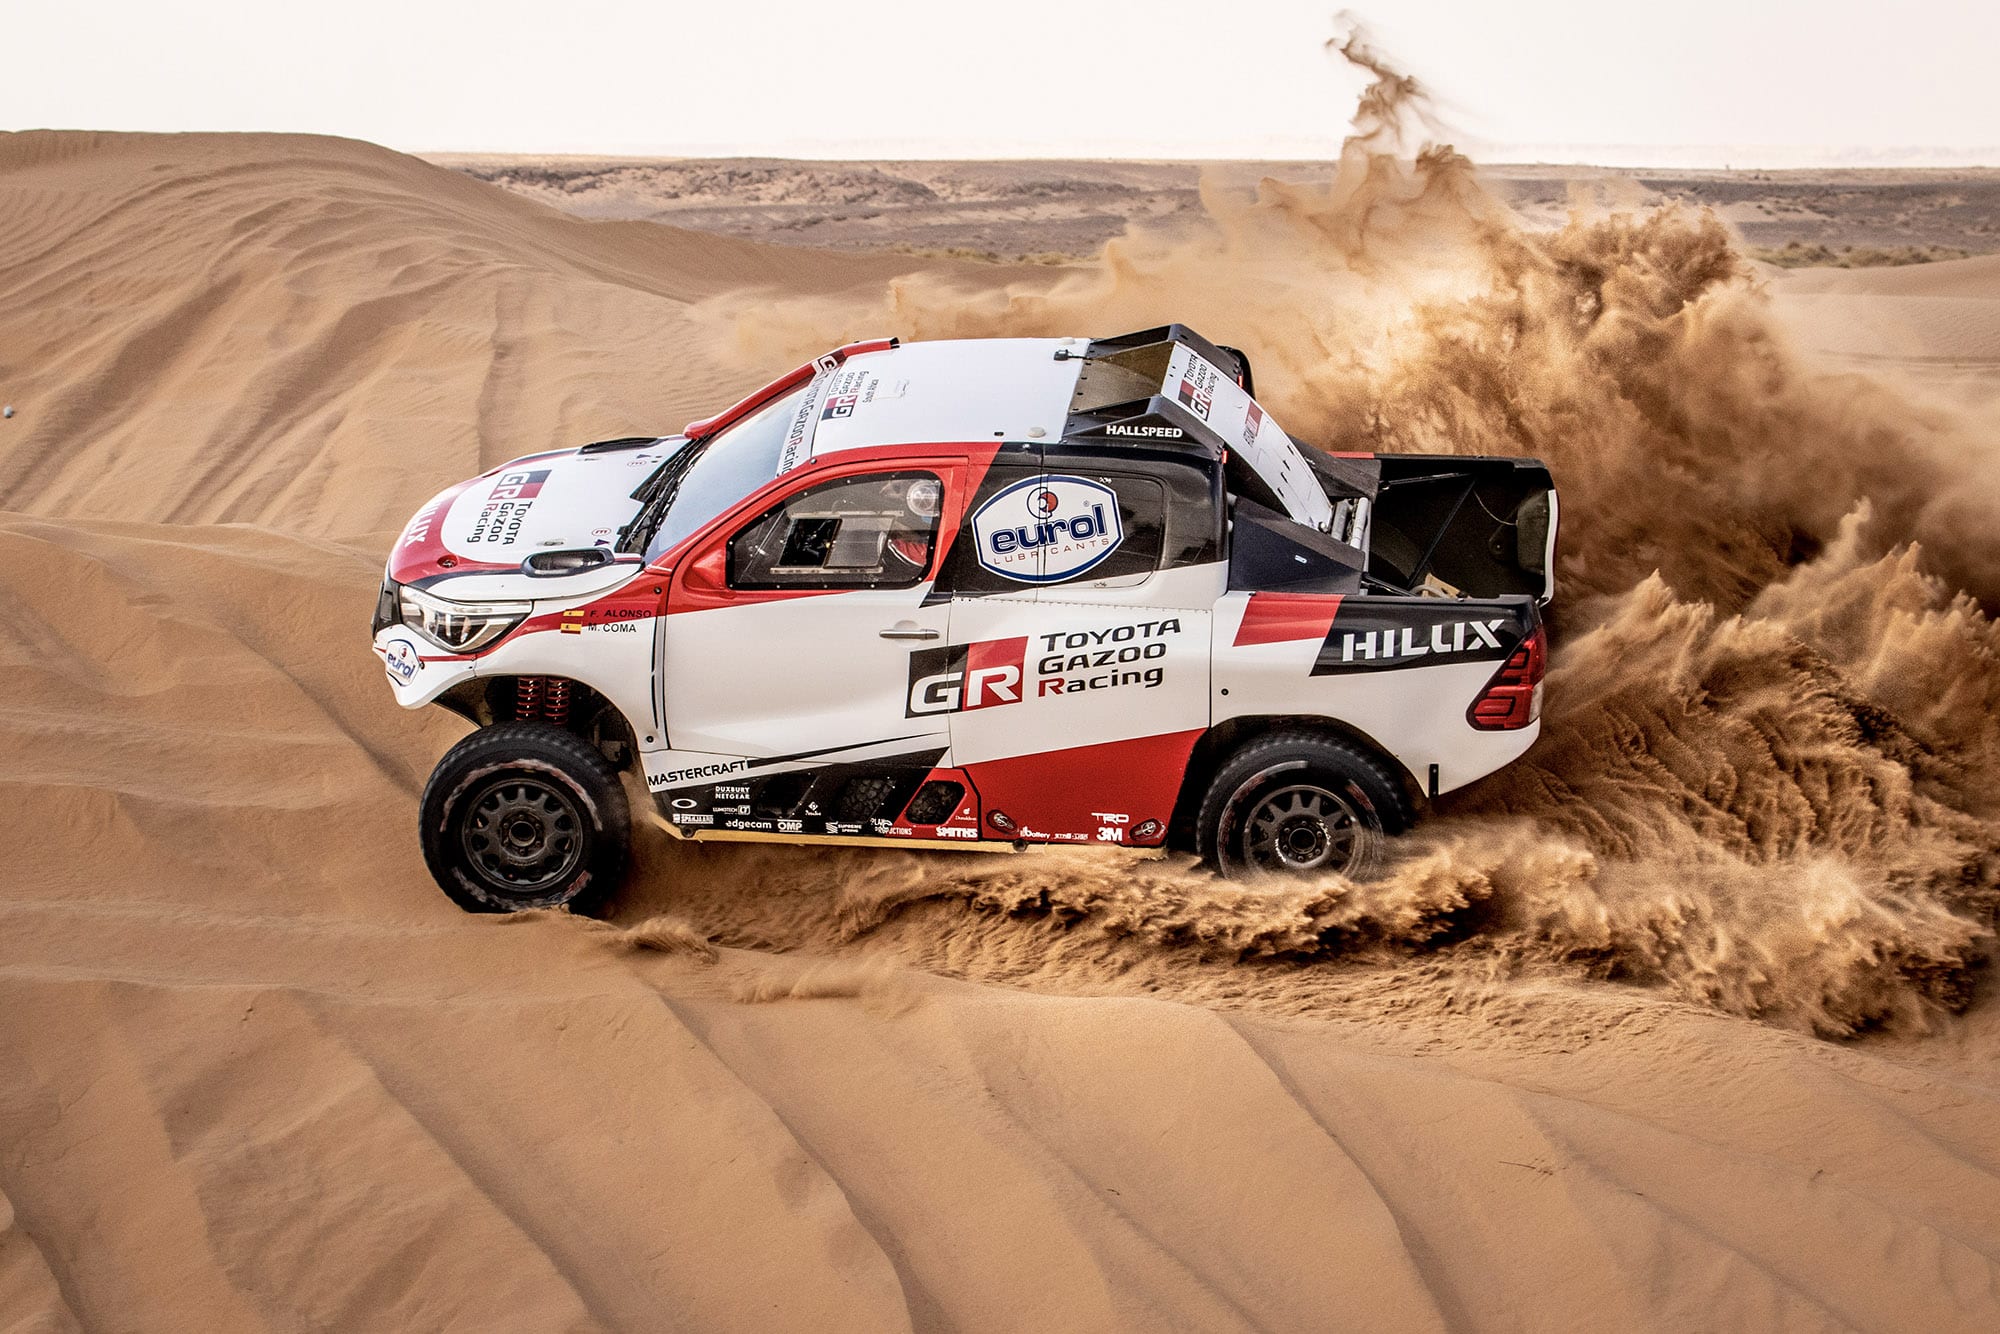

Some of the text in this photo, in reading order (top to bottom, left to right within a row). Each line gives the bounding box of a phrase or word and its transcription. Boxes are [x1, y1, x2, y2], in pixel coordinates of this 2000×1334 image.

[1183, 354, 1199, 381] TOYOTA
[1194, 364, 1207, 389] GAZOO
[1203, 372, 1219, 397] Racing
[832, 395, 858, 418] GR
[1191, 388, 1211, 419] GR
[1106, 425, 1183, 438] HALLSPEED
[489, 472, 531, 500] GR
[467, 503, 499, 544] Racing
[488, 502, 514, 543] GAZOO
[503, 501, 533, 545] TOYOTA
[990, 504, 1107, 554] eurol
[604, 610, 652, 618] ALONSO
[588, 622, 637, 632] M. COMA
[1040, 619, 1181, 652] TOYOTA
[1343, 619, 1505, 661] HILUX
[387, 653, 416, 678] eurol
[1037, 643, 1167, 675] GAZOO
[911, 664, 1021, 714] GR
[1037, 667, 1164, 697] Racing
[648, 761, 747, 786] MASTERCRAFT
[725, 819, 772, 830] edgecam
[778, 821, 802, 831] OMP
[1091, 812, 1129, 824] TRD
[936, 827, 978, 838] SMITHS
[1096, 827, 1122, 841] 3M
